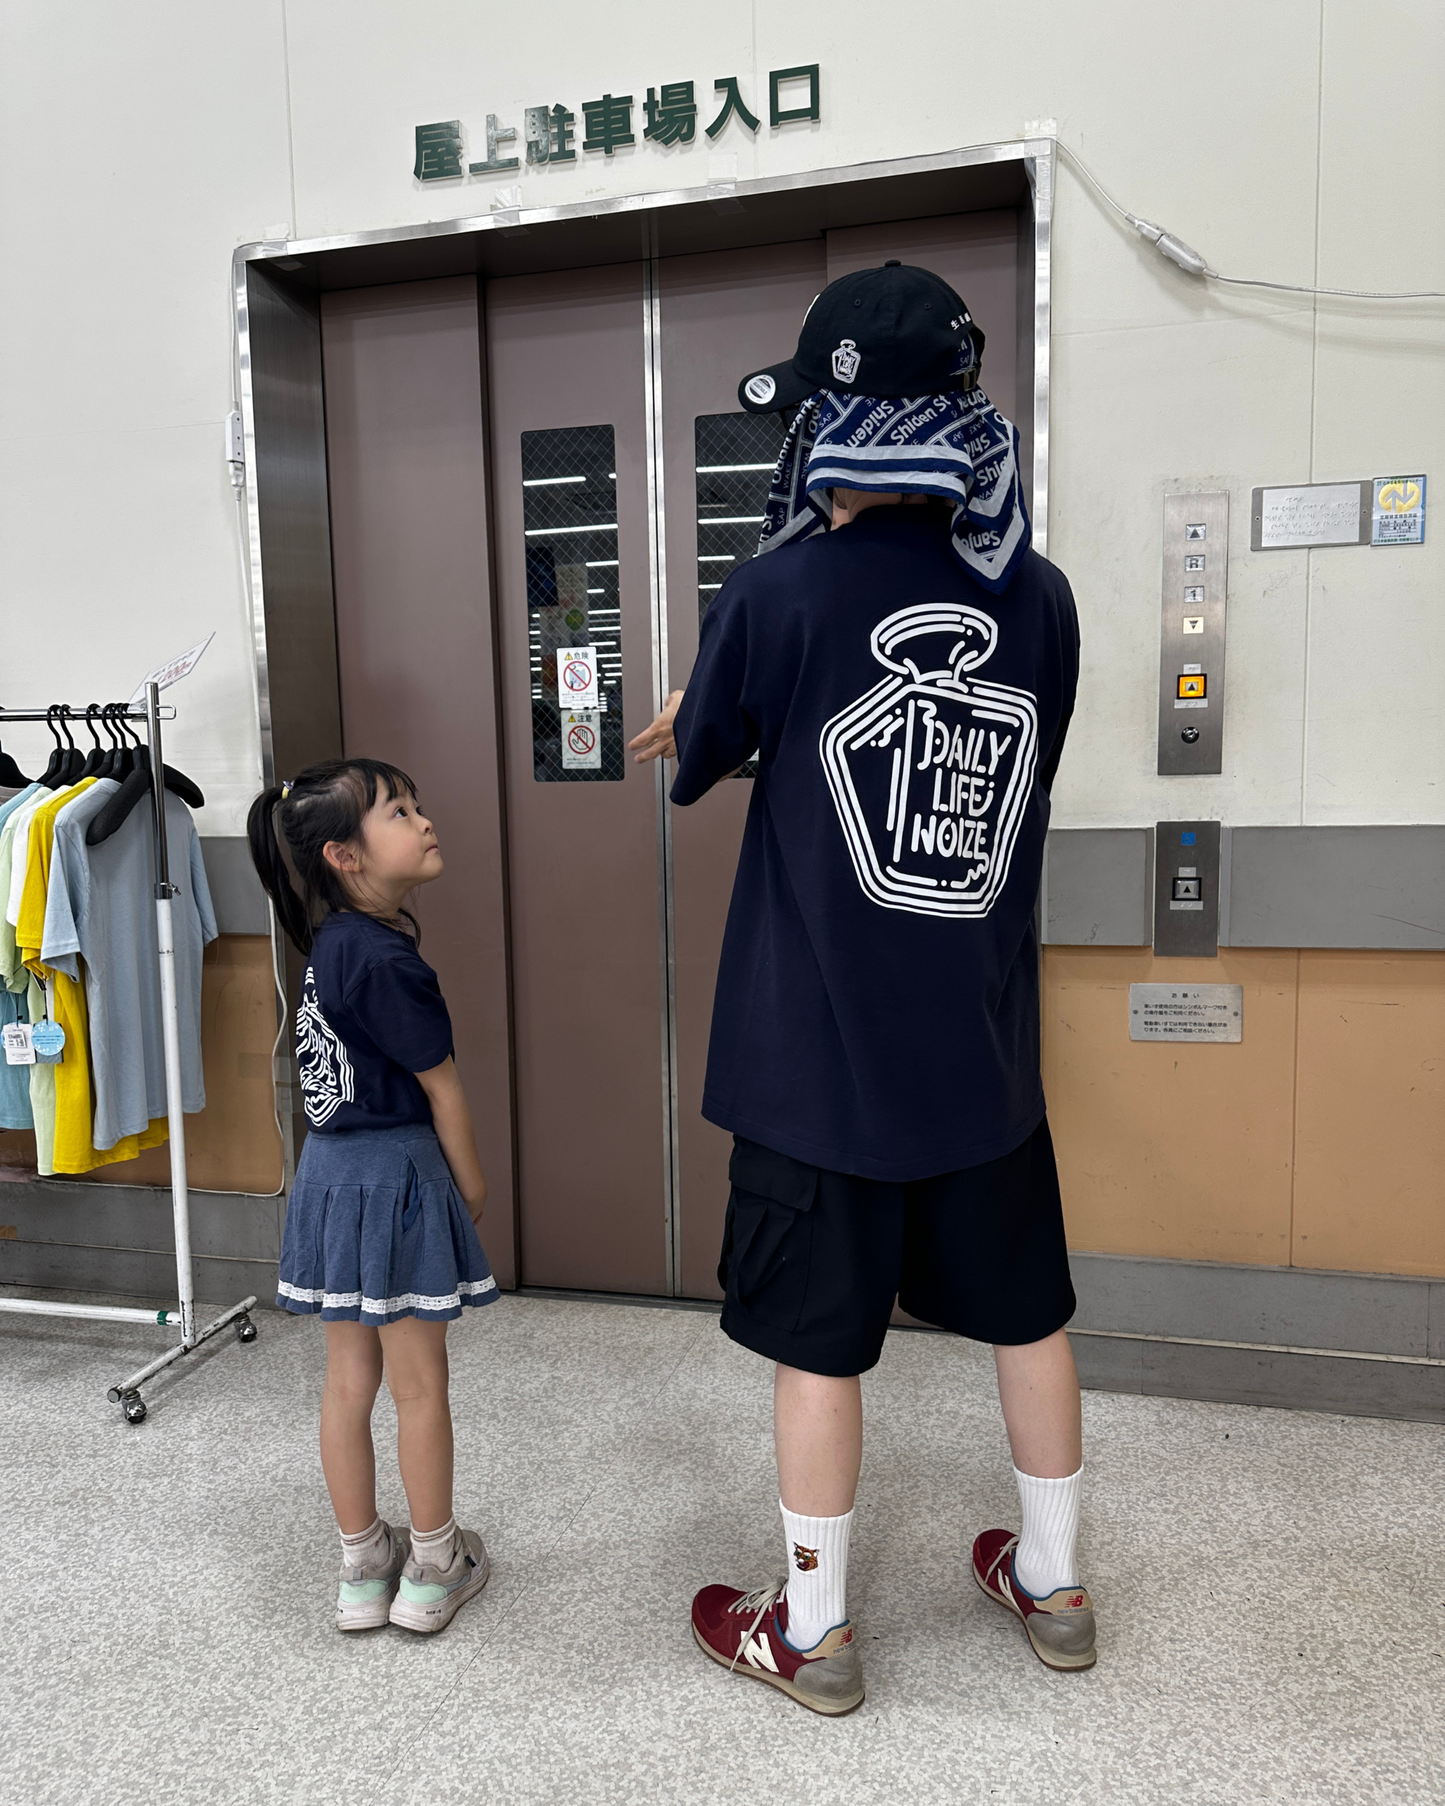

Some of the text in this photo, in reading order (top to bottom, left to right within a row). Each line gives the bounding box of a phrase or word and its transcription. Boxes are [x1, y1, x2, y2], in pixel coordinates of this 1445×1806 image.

[413, 63, 820, 182] 屋上駐車場入口
[789, 397, 817, 434] Park
[819, 412, 833, 428] SAP
[846, 400, 895, 447] Shiden
[890, 407, 938, 446] Shiden
[933, 394, 952, 413] St
[776, 507, 785, 526] SAP
[1189, 558, 1199, 569] R
[1190, 589, 1196, 600] 1
[573, 651, 589, 660] 危険
[577, 714, 592, 722] 注意
[917, 700, 1012, 775] DAILY
[932, 768, 993, 817] LIFE
[911, 813, 989, 859] NOIZE
